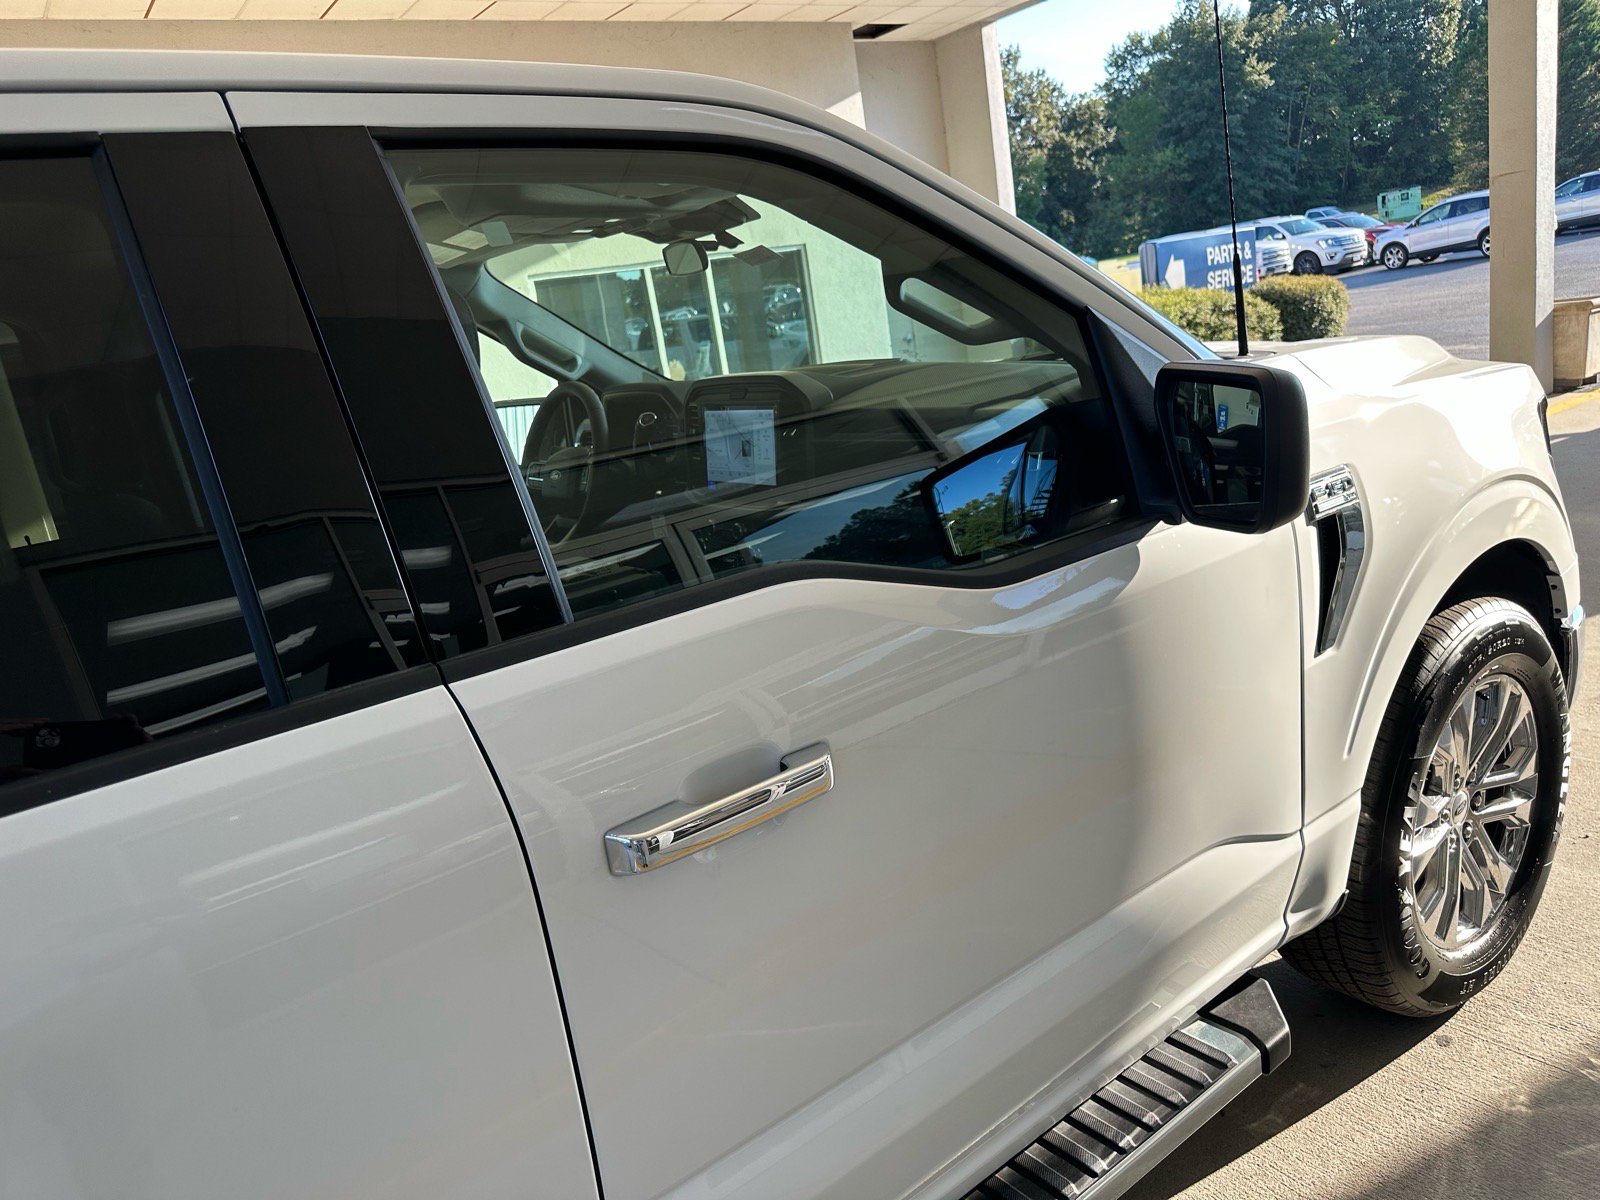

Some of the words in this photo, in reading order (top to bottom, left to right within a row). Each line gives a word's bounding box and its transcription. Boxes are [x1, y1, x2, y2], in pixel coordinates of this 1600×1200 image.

[1206, 242, 1242, 266] PARTS
[1244, 240, 1252, 260] &
[1207, 264, 1254, 290] SERVCE
